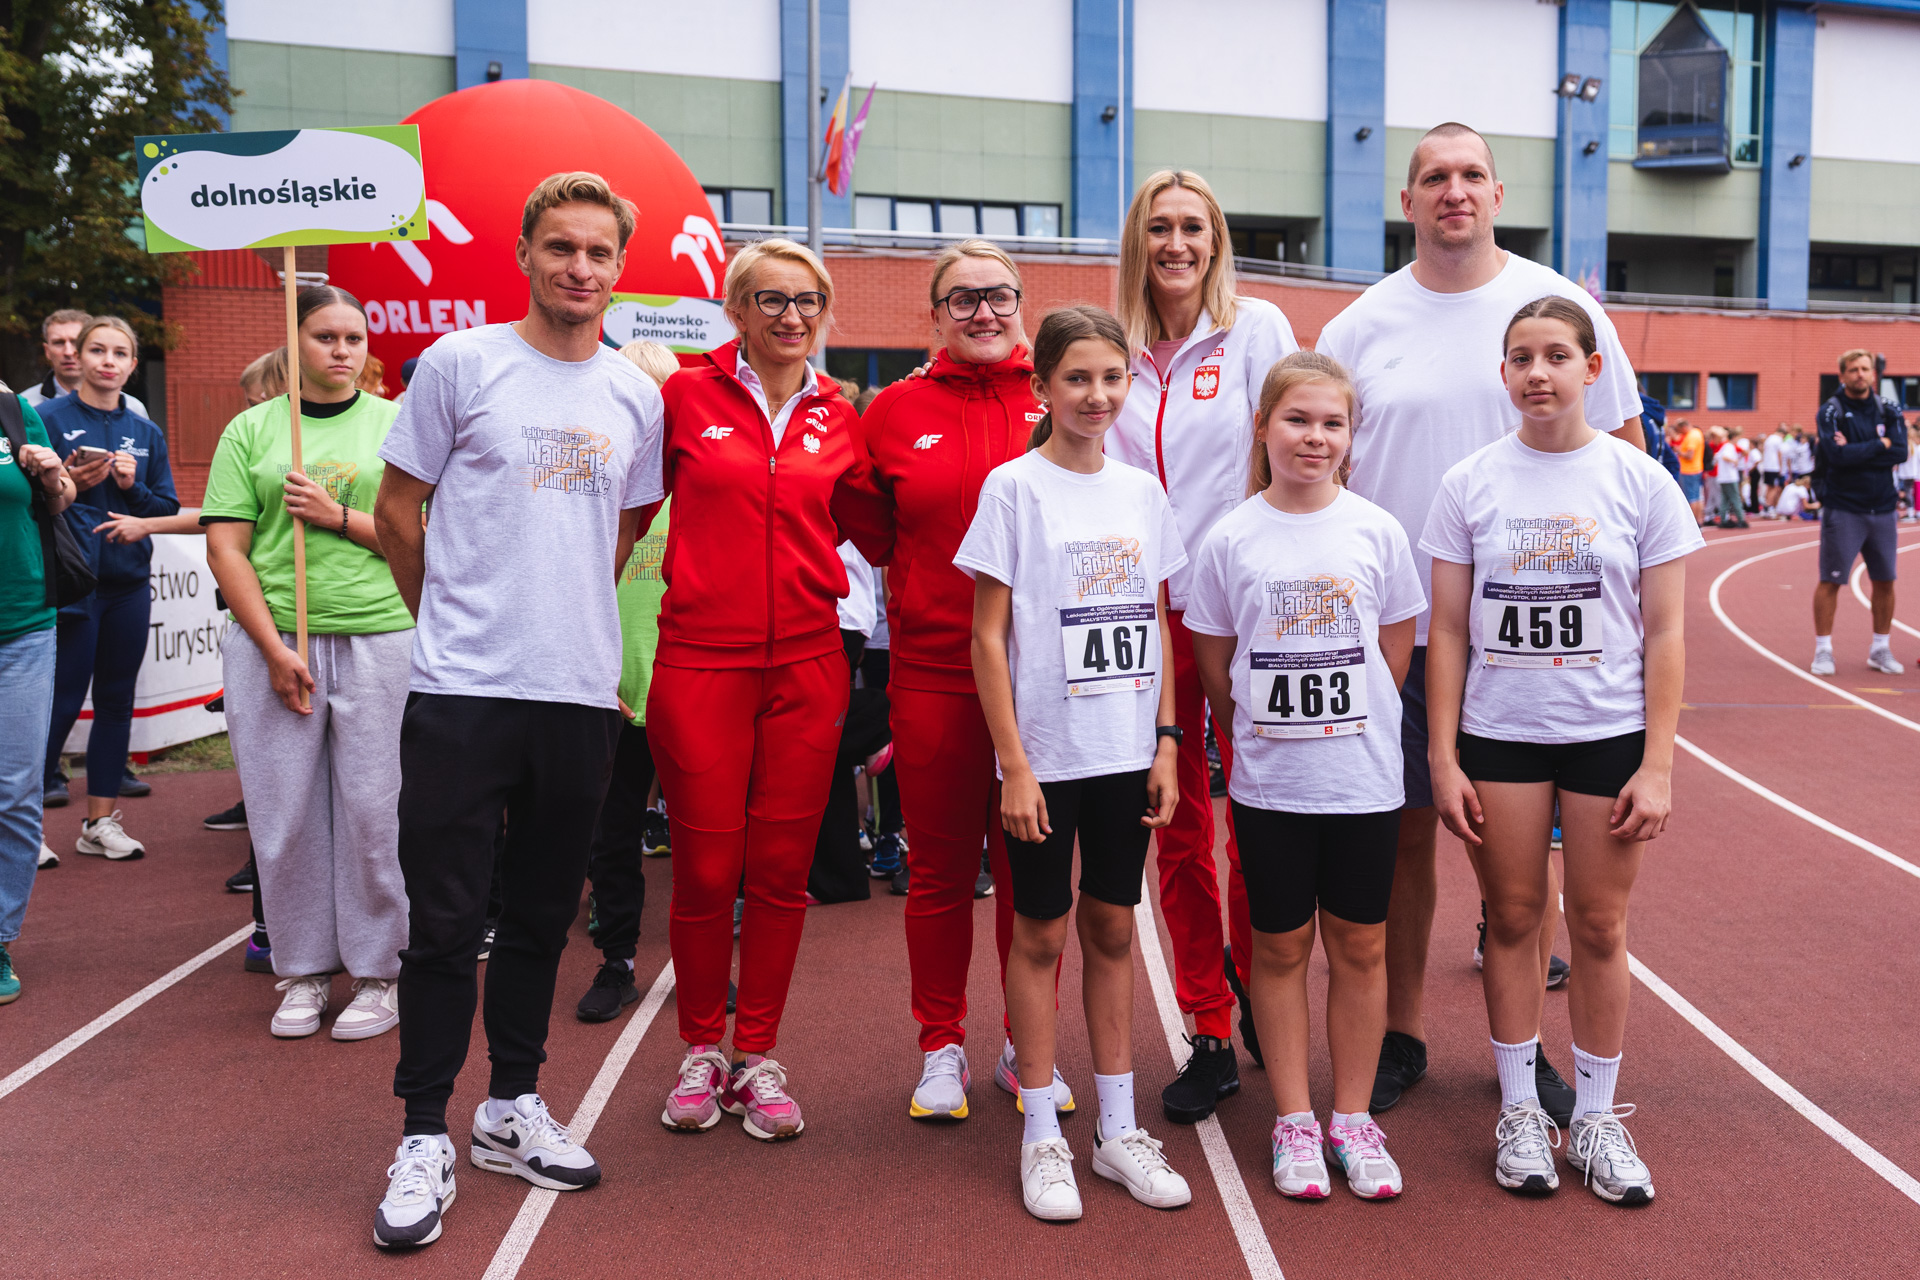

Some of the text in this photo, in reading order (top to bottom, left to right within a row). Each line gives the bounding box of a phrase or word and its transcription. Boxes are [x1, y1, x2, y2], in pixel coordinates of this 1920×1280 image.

[190, 176, 377, 208] dolnośląskie
[364, 299, 487, 335] ORLEN
[635, 312, 710, 326] kujawsko-
[632, 328, 707, 340] pomorskie
[805, 418, 828, 433] ORLEN
[527, 439, 606, 474] Nadzieje
[1506, 518, 1574, 530] Lekkoatletyczne
[1065, 541, 1122, 553] Lekkoatletyczne
[1508, 528, 1591, 554] Nadzieje
[1071, 550, 1136, 578] Nadzieje
[1514, 551, 1602, 574] Olimpijskie
[1078, 574, 1145, 597] Olimpijskie
[1266, 580, 1334, 592] Lekkoatletyczne
[1271, 591, 1350, 616] Nadzieje
[1278, 615, 1360, 638] Olimpijskie
[1498, 605, 1583, 649] 459
[1083, 625, 1147, 673] 467
[1268, 671, 1350, 718] 463
